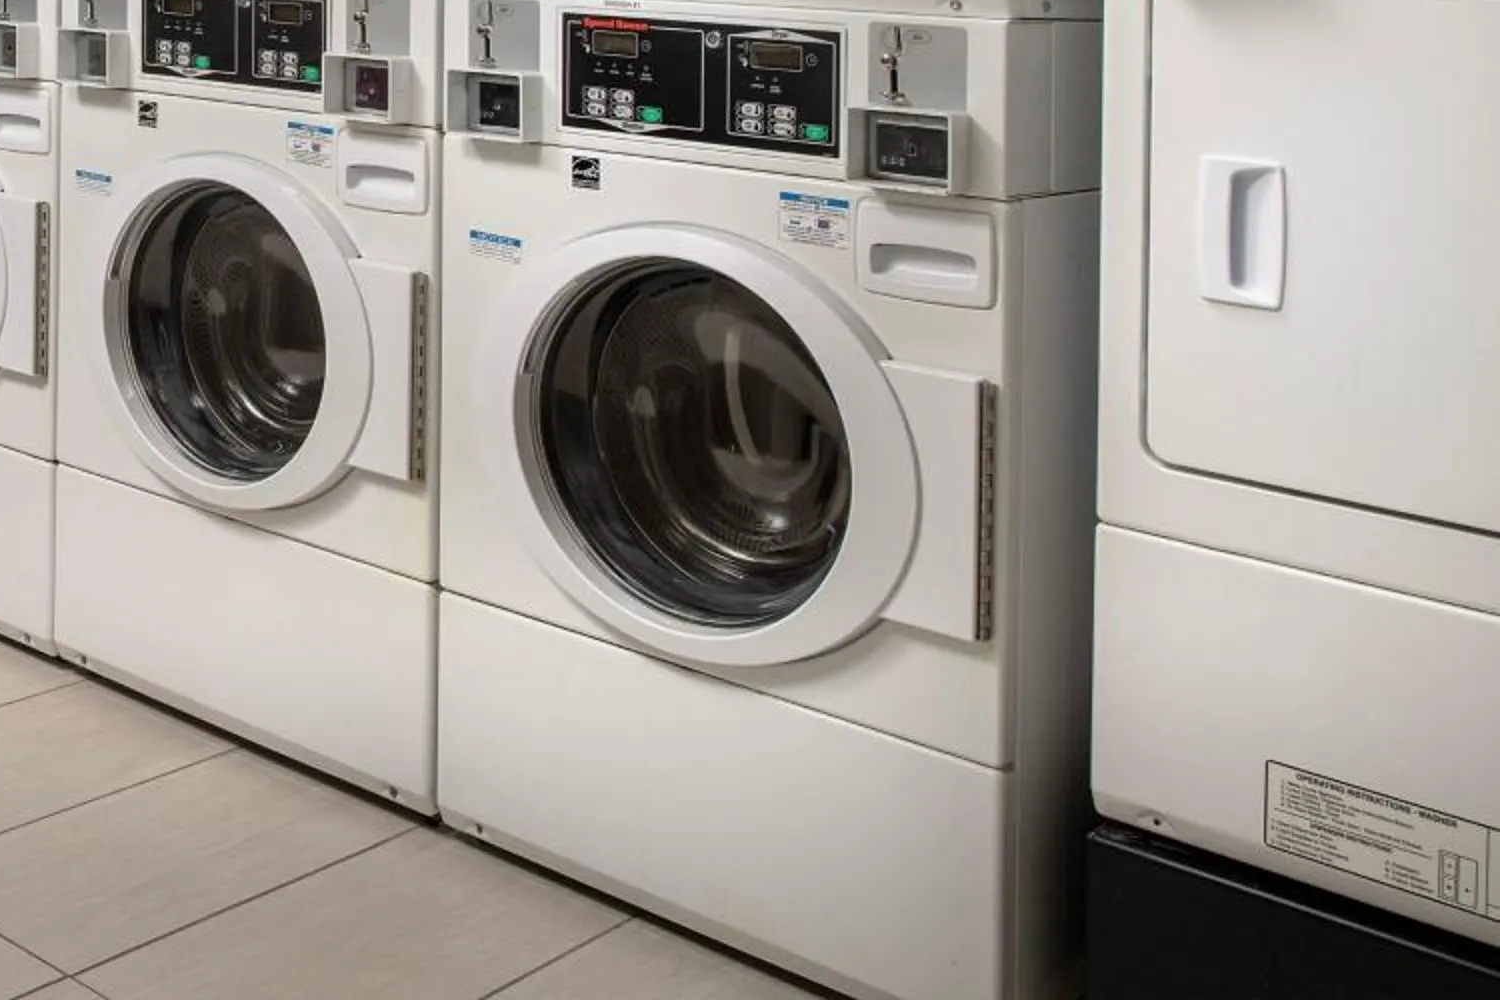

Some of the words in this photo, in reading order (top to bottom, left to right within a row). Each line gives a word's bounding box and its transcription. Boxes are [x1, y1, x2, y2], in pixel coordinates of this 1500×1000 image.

[1295, 774, 1345, 794] OPERATING
[1347, 788, 1411, 815] INSTRUCTIONS
[1418, 811, 1458, 828] WASHER
